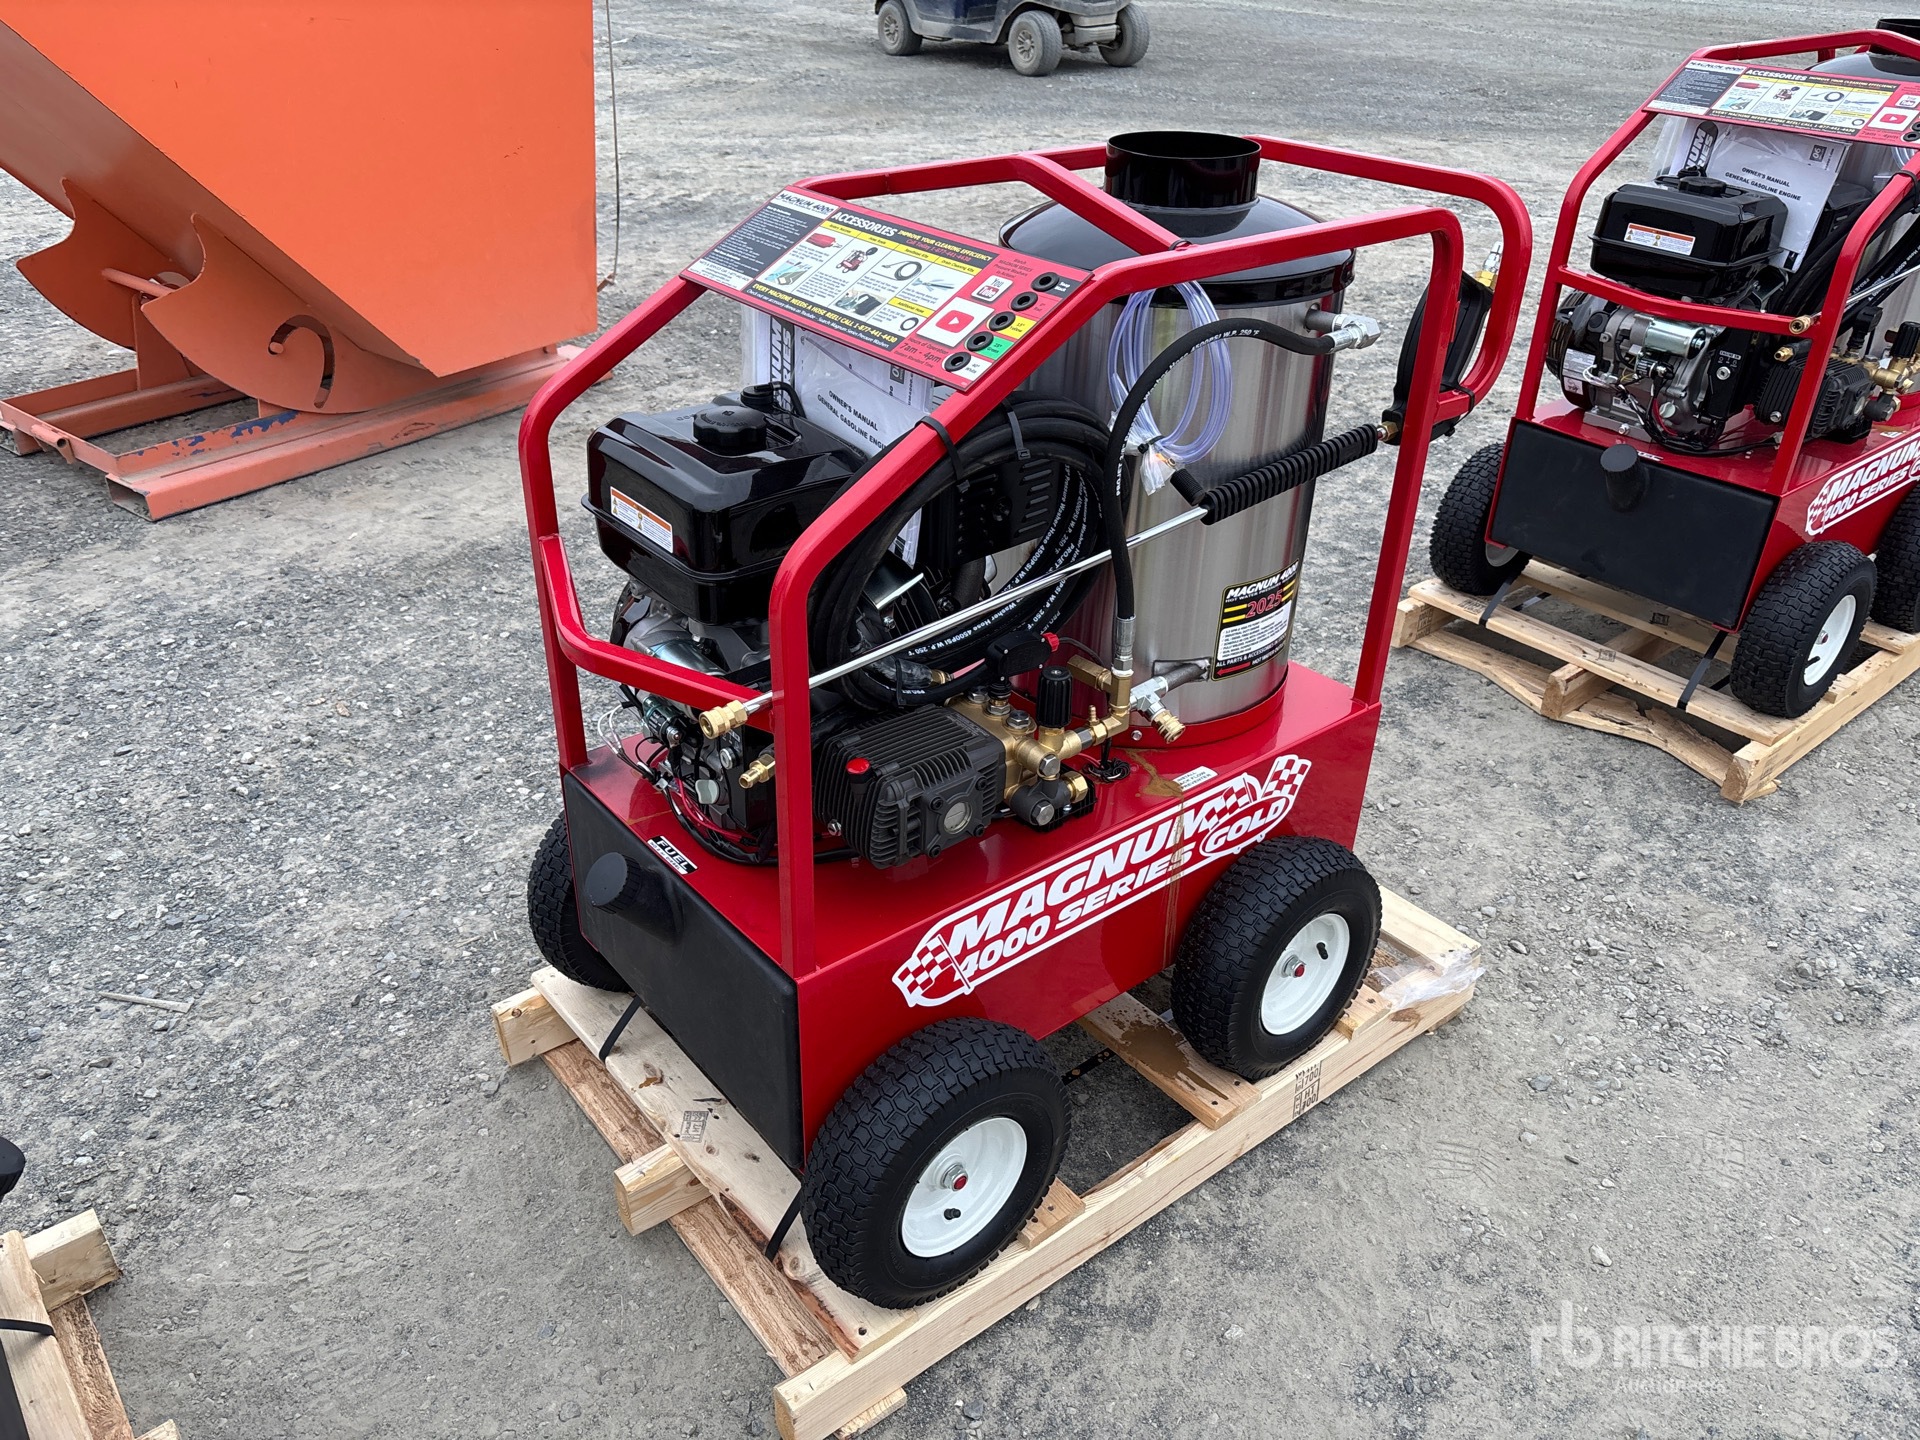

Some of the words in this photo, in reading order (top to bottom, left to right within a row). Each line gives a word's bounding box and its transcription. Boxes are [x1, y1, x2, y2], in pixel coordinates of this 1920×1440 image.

[1747, 70, 1809, 80] ACCESSORIES
[1725, 171, 1749, 185] GENERAL
[1750, 180, 1778, 194] GASOLINE
[1779, 190, 1802, 201] ENGINE
[1741, 167, 1766, 179] OWNER'S
[1767, 175, 1790, 187] MANUAL
[778, 193, 814, 206] MAGNUM
[831, 212, 898, 236] ACCESSORIES
[897, 230, 923, 239] IMPROVE
[933, 241, 961, 251] CLEANING
[959, 249, 992, 260] EFFICIENCY
[978, 287, 998, 297] Tube
[990, 278, 1005, 286] You
[751, 284, 769, 292] EVERY
[766, 290, 791, 301] MACHINE
[789, 298, 808, 307] NEEDS
[825, 312, 841, 320] REEL!
[853, 323, 897, 342] 1-877-441-4430
[829, 322, 847, 331] Magnum
[872, 339, 890, 347] Washers
[899, 343, 919, 353] 7am
[921, 352, 942, 363] 4pm
[925, 344, 948, 354] Operation
[828, 390, 852, 414] OWNER'S
[852, 409, 879, 432] MANUAL
[817, 393, 840, 419] GENERAL
[840, 413, 869, 440] GASOLINE
[868, 435, 887, 450] ENGI
[1821, 491, 1859, 522] 4000
[1855, 465, 1910, 503] SERIES
[1053, 503, 1066, 528] Washer
[1043, 526, 1056, 544] Hose
[1024, 544, 1046, 572] 4500PSI
[1054, 543, 1075, 569] PROJET
[1013, 571, 1026, 585] W.P.
[1226, 574, 1281, 599] MAGNUM
[1043, 594, 1057, 608] W.P.
[1245, 588, 1283, 619] 2025
[991, 602, 1017, 621] Washer
[1032, 608, 1045, 622] 250
[972, 619, 992, 632] Hose
[929, 642, 945, 650] W.P.
[945, 629, 973, 646] 4500PSI
[914, 646, 928, 655] 250
[1226, 656, 1243, 665] PARTS
[1180, 773, 1212, 789] PREVENTER
[1191, 771, 1206, 780] FLOW
[1206, 799, 1284, 851] GOLD
[656, 840, 688, 870] FUEL
[943, 798, 1222, 955] MAGNUM
[953, 914, 1050, 981] 4000
[1054, 840, 1202, 930] SERIES
